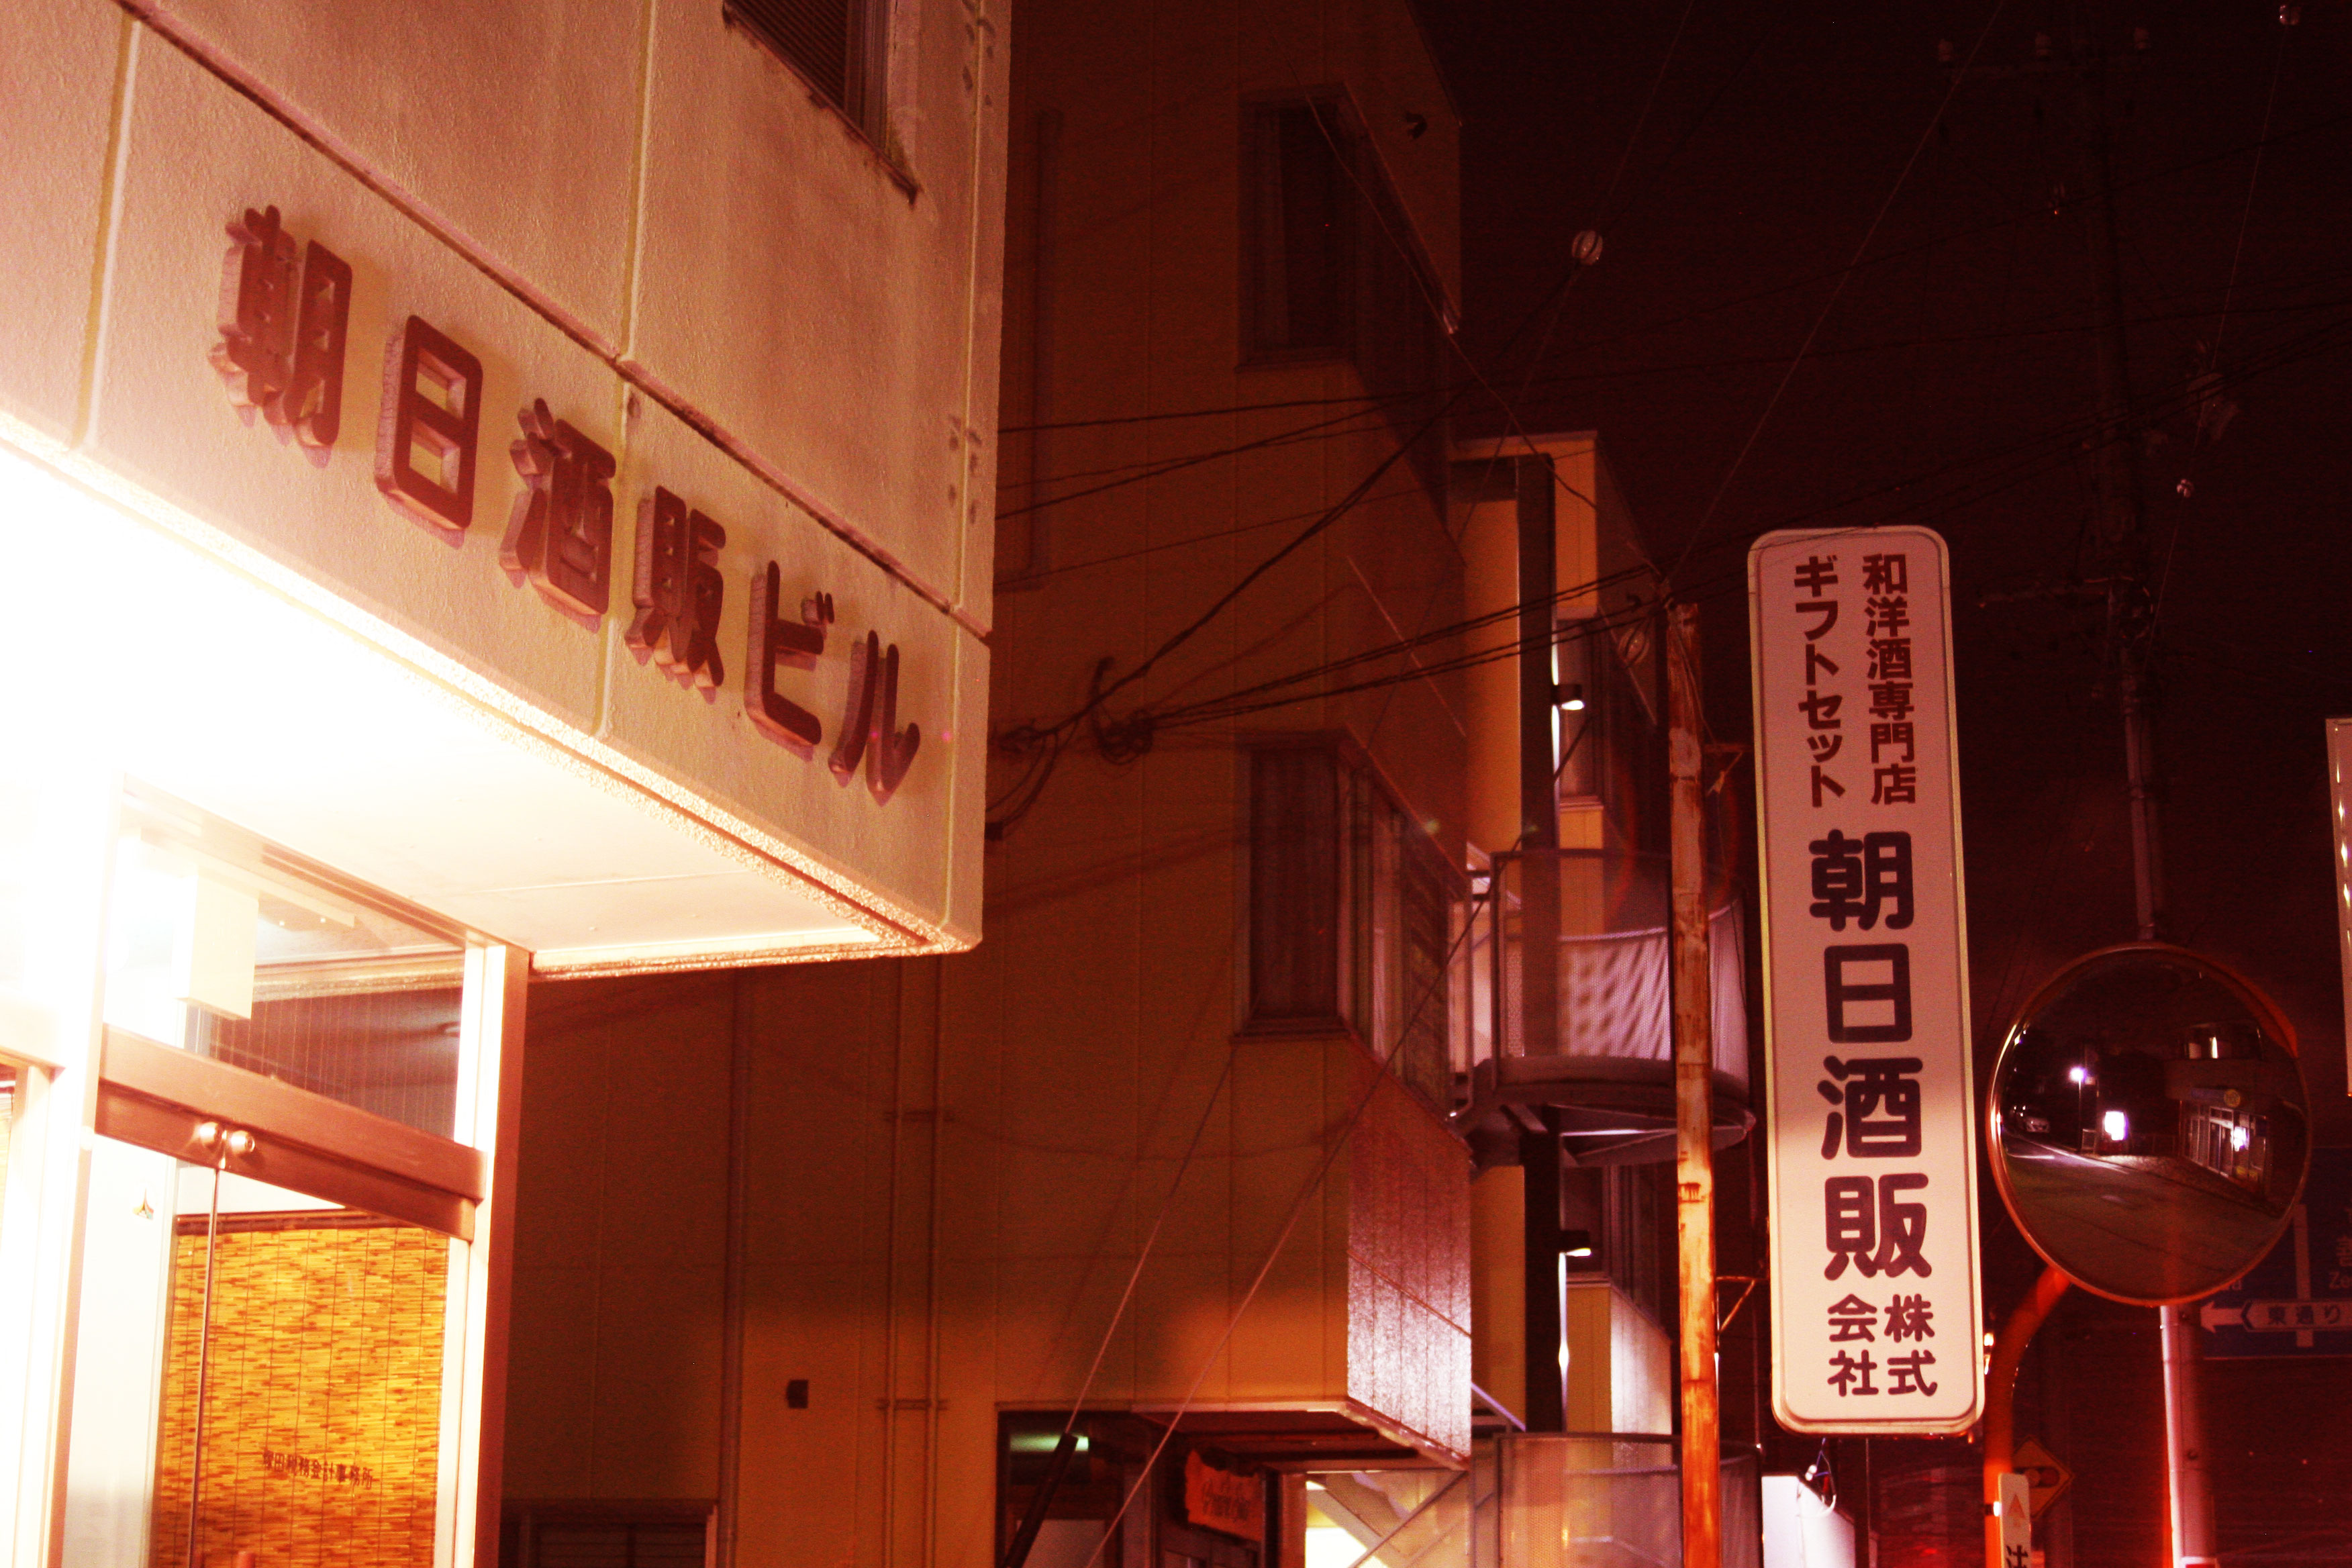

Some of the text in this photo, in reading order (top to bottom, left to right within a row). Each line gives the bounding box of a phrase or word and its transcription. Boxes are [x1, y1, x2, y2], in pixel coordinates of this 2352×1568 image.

[212, 205, 920, 799] 朝日酒販ビル
[1794, 555, 1845, 807] ギフトセット
[1862, 553, 1916, 805] 和洋酒専門店
[1808, 829, 1932, 1281] 朝日酒販
